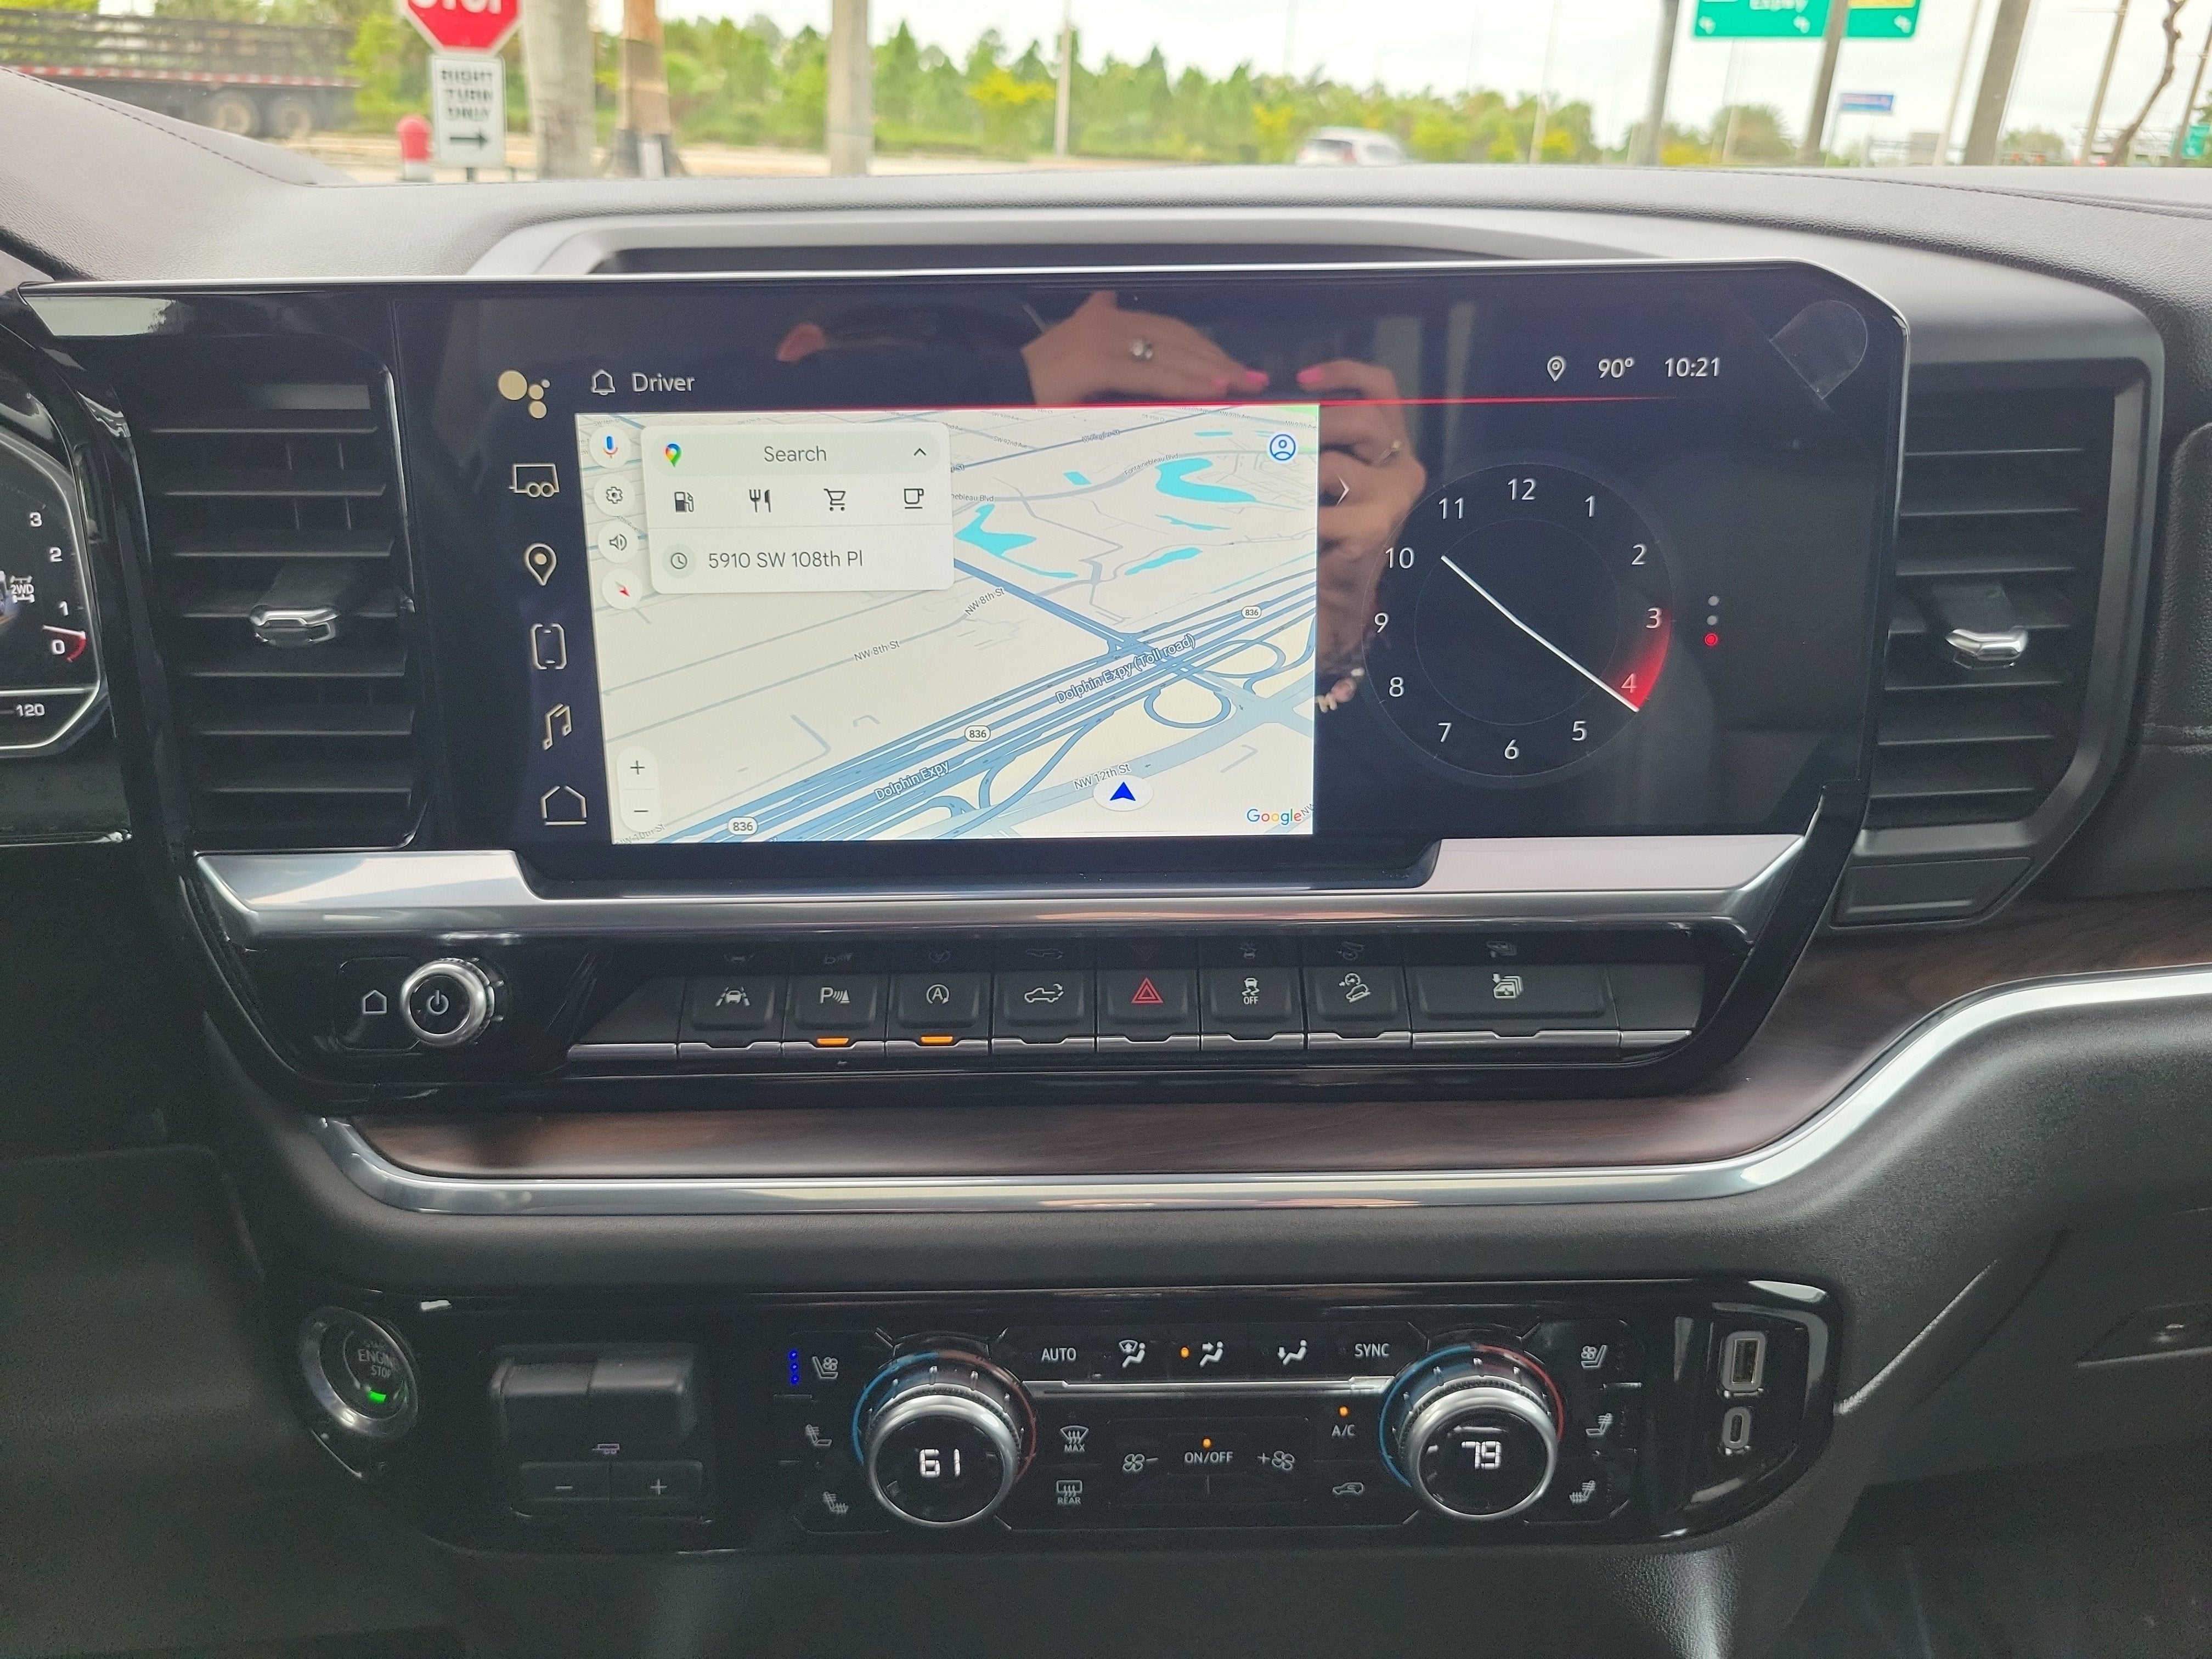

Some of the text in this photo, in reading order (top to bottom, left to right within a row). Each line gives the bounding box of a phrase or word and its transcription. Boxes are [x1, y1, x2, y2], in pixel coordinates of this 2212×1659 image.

[1664, 358, 1721, 377] 10:21
[632, 373, 695, 392] Driver
[764, 445, 827, 462] Search
[1124, 453, 1178, 476] Fontainebleau Blvd
[1508, 479, 1537, 500] 12
[1438, 498, 1465, 519] 11
[1585, 495, 1596, 517] 1
[30, 511, 42, 527] 3
[50, 547, 63, 563] 2
[709, 550, 863, 568] 5910 SW 108th Pl
[1385, 547, 1414, 568] 10
[1632, 544, 1646, 566] 2
[10, 584, 34, 595] 2WD
[59, 601, 69, 616] 1
[964, 586, 1005, 616] NW 8th St
[1245, 609, 1259, 617] 836
[1374, 612, 1389, 633] 9
[1646, 607, 1662, 629] 3
[52, 639, 65, 655] 0
[854, 639, 900, 662] NW 8th St
[1055, 633, 1197, 704] Dolphin Expy (Toll road)
[1389, 676, 1404, 697] 8
[1621, 673, 1637, 693] 4
[15, 703, 45, 716] 120
[969, 729, 987, 738] 836
[1438, 722, 1452, 742] 7
[1572, 720, 1588, 741] 5
[1504, 740, 1520, 760] 6
[874, 760, 950, 802] Dolphin Expy
[1073, 763, 1131, 790] NW 12th St
[1246, 809, 1302, 825] Google
[733, 822, 753, 832] 836
[1243, 996, 1259, 1006] OFF
[1041, 1347, 1077, 1362] AUTO
[1355, 1343, 1390, 1358] SYNC
[1331, 1424, 1355, 1438] A/C
[1064, 1443, 1086, 1453] MAX
[1184, 1451, 1233, 1464] ON/OFF
[1461, 1441, 1502, 1470] 79
[919, 1448, 961, 1478] 61
[1057, 1496, 1082, 1505] REAR
